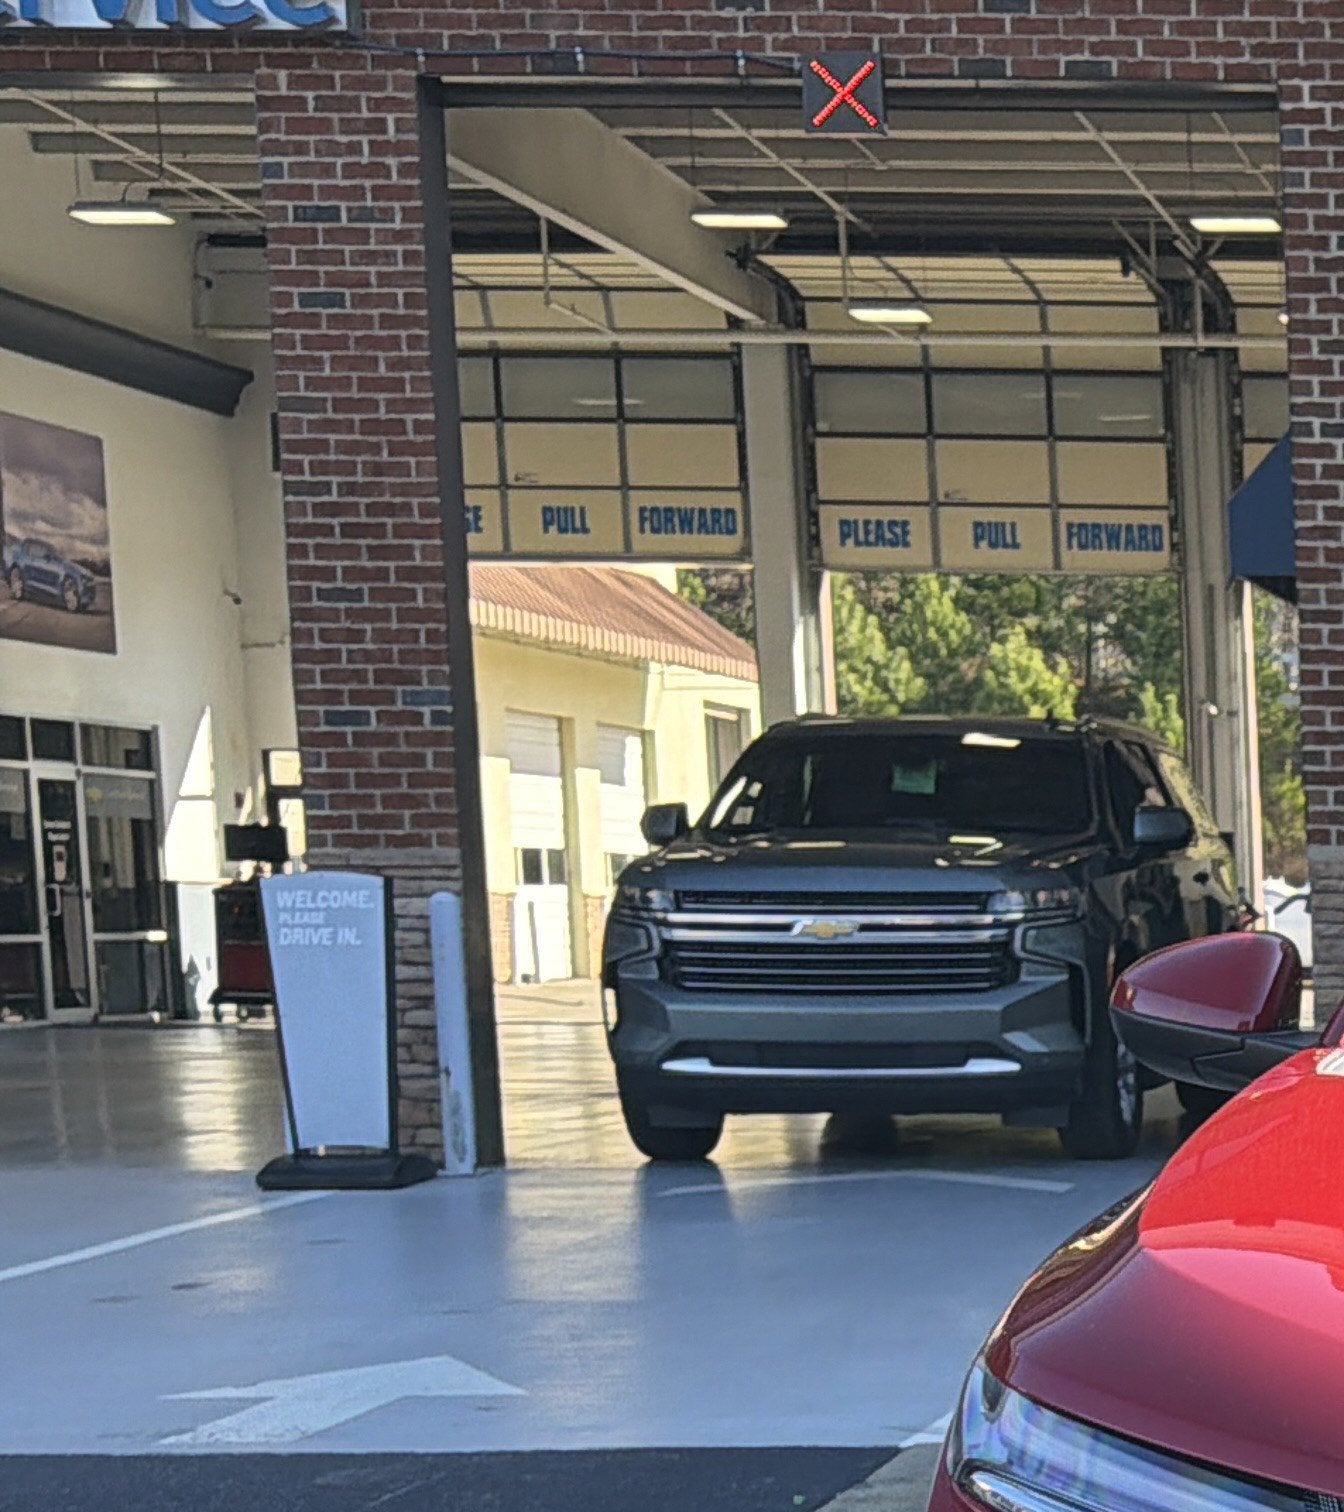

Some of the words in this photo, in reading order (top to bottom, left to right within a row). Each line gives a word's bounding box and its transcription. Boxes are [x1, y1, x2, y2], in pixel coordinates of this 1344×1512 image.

[541, 504, 591, 534] PULL
[638, 505, 738, 536] FORWARD
[838, 518, 911, 548] PLEASE
[972, 520, 1020, 550] PULL
[1066, 521, 1164, 552] FORWARD
[276, 889, 376, 909] WELCOME.
[280, 926, 335, 946] DRIVE
